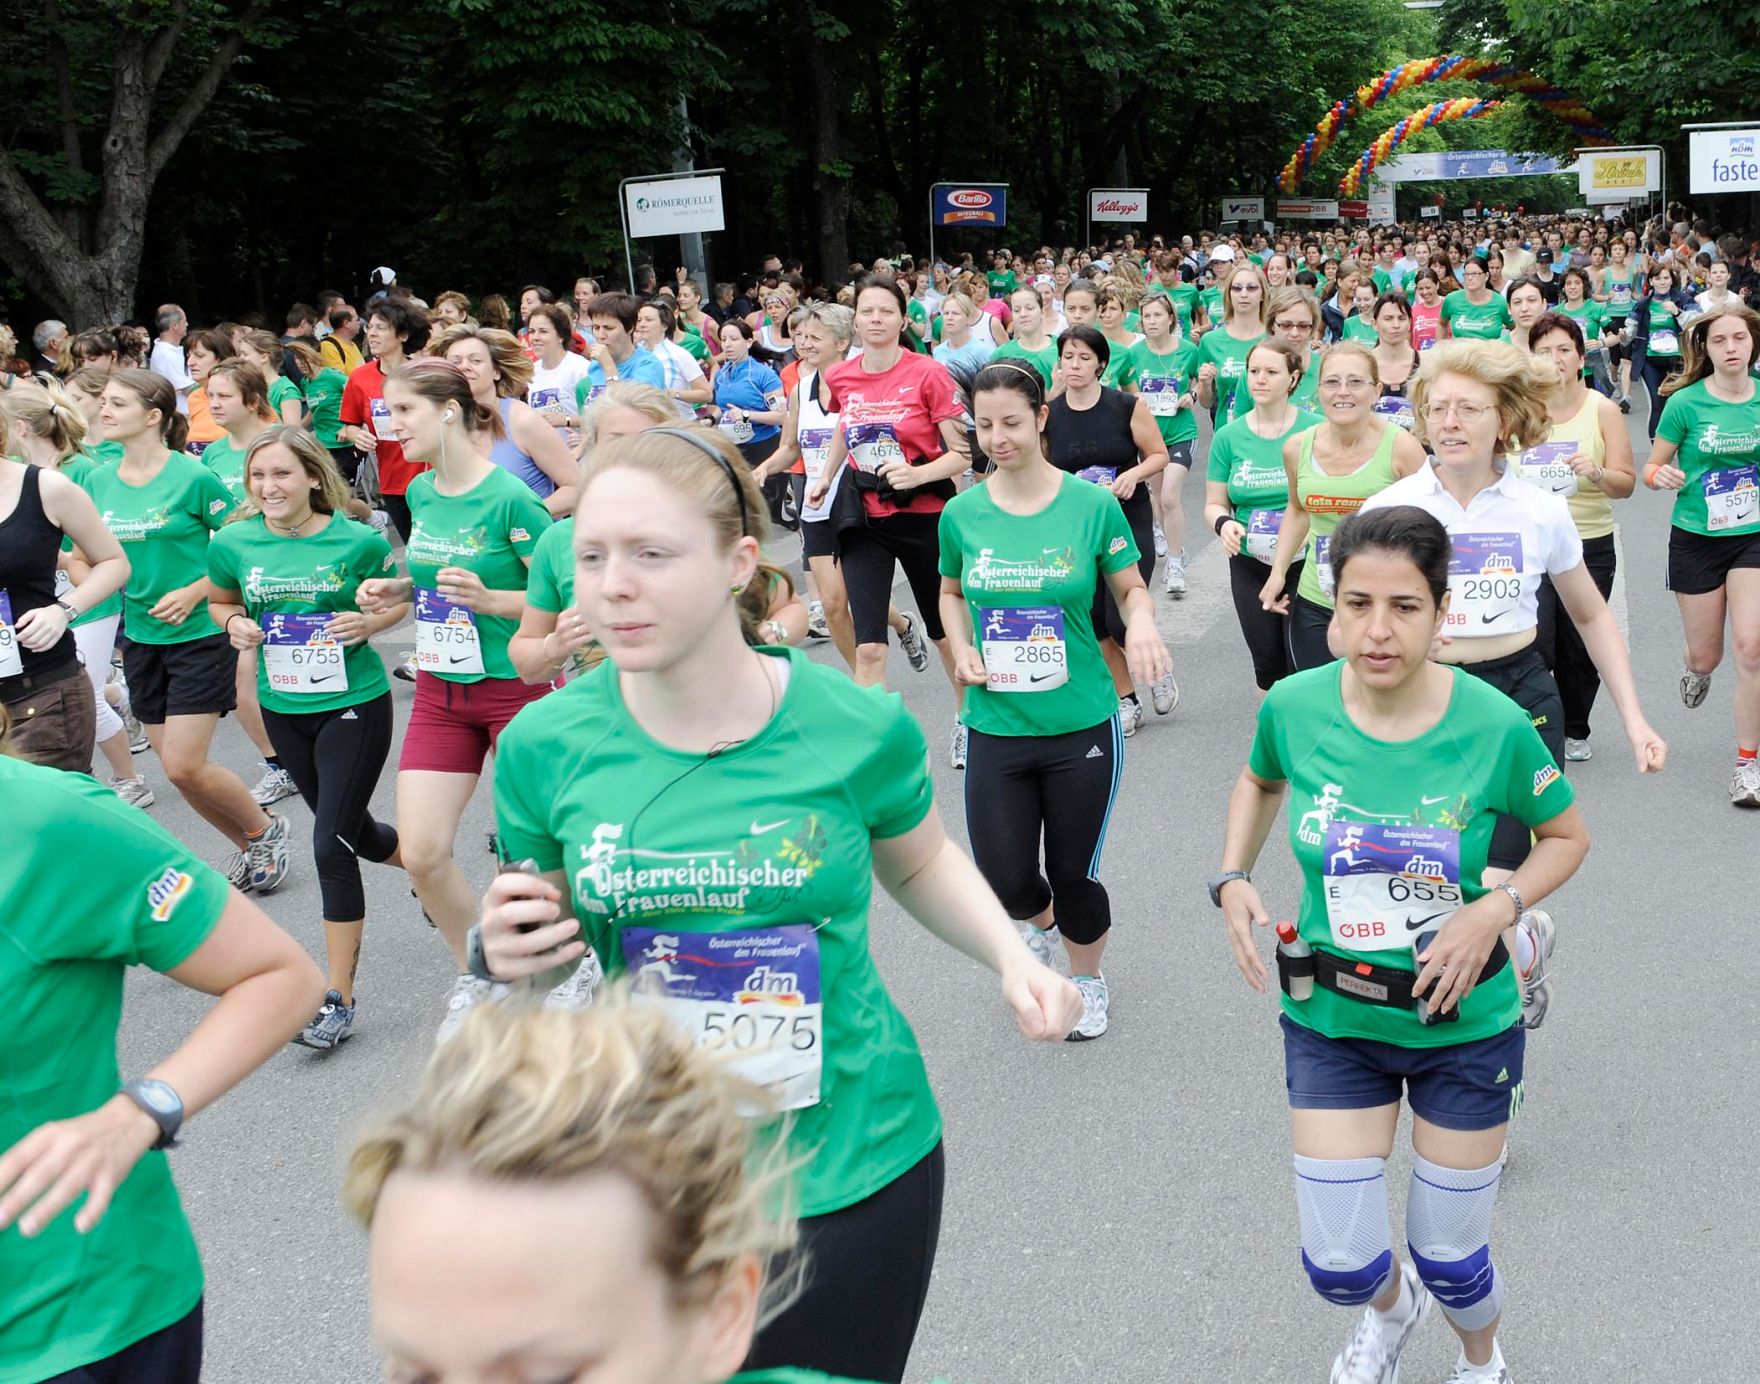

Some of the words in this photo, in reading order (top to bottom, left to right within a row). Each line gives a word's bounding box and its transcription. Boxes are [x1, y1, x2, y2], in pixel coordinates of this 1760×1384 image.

[652, 196, 714, 208] RÖMERQUELLE
[958, 194, 987, 203] Barilla
[1097, 200, 1138, 215] Kellogg's
[733, 423, 752, 433] 695
[870, 444, 902, 458] 4679
[1540, 466, 1574, 479] 6654
[1726, 490, 1759, 508] 5579
[1487, 555, 1510, 568] dm
[979, 565, 1067, 580] Österreichischer
[253, 581, 341, 596] Österreichischer
[985, 576, 1044, 591] Frauenlauf
[1464, 579, 1520, 600] 2903
[261, 591, 318, 604] Frauenlauf
[451, 608, 469, 621] dm
[1446, 614, 1467, 625] BB
[434, 626, 476, 644] 6754
[1032, 624, 1053, 637] dm
[292, 649, 340, 665] 6755
[985, 647, 992, 656] E
[1014, 646, 1064, 664] 2865
[1535, 766, 1553, 786] dm
[1300, 826, 1322, 846] dm
[1383, 829, 1435, 841] Österreichischer
[1400, 838, 1412, 847] dm
[1412, 839, 1447, 850] Frauenlauf
[1407, 859, 1441, 876] dm
[597, 858, 808, 897] Österreichischer
[151, 872, 179, 905] dm
[1330, 886, 1341, 899] E
[1388, 877, 1460, 902] 655
[613, 887, 750, 918] Frauenlauf
[1340, 921, 1386, 938] ÖBB
[708, 935, 783, 950] Österreichischer
[734, 948, 750, 959] dm
[752, 943, 801, 958] Frauenlauf
[749, 970, 792, 993] dm
[703, 1013, 816, 1051] 5075
